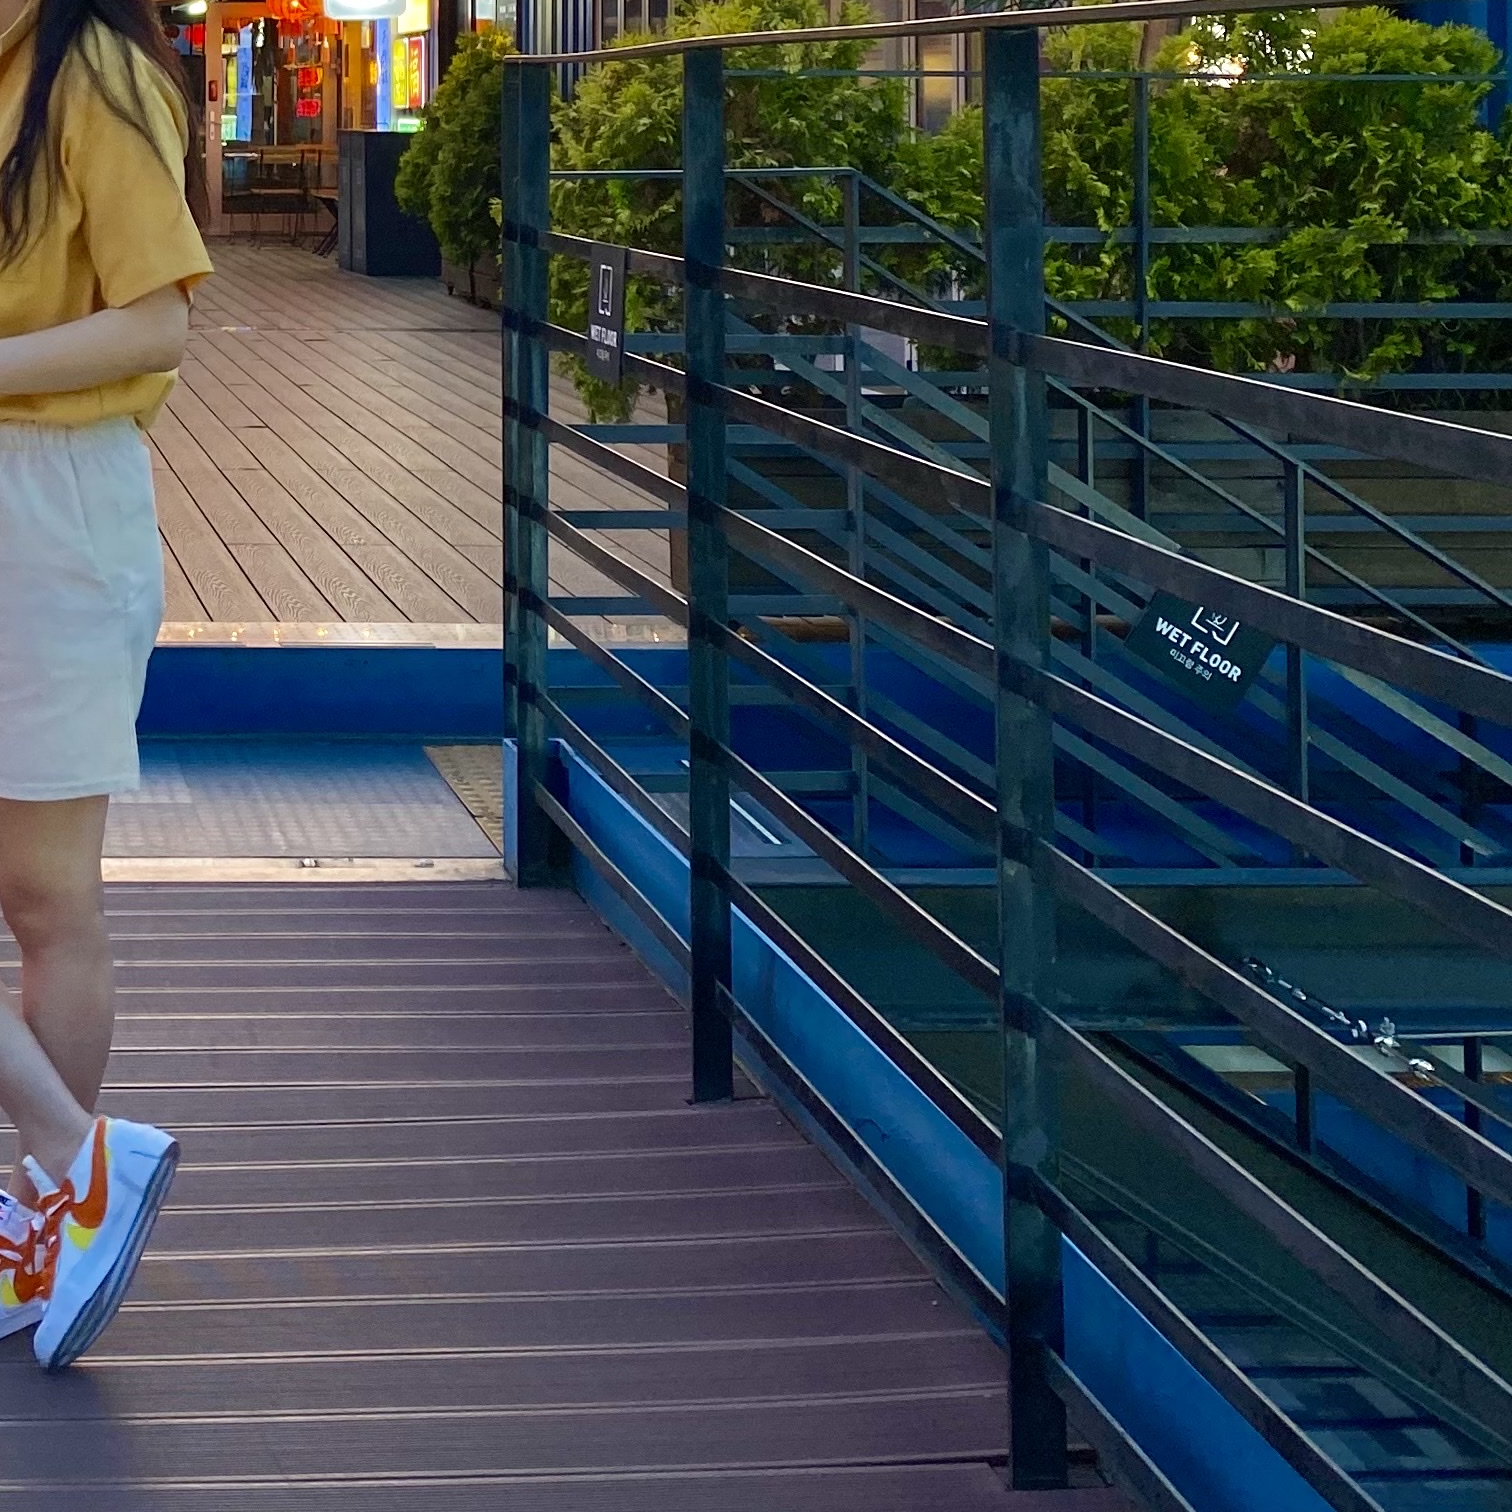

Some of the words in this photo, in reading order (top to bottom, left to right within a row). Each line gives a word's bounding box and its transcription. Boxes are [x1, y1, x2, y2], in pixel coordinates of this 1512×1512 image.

[1155, 616, 1192, 648] WET
[1190, 641, 1242, 682] FLOOR
[1169, 648, 1195, 670] 미끄럼
[1194, 663, 1213, 681] 주의
